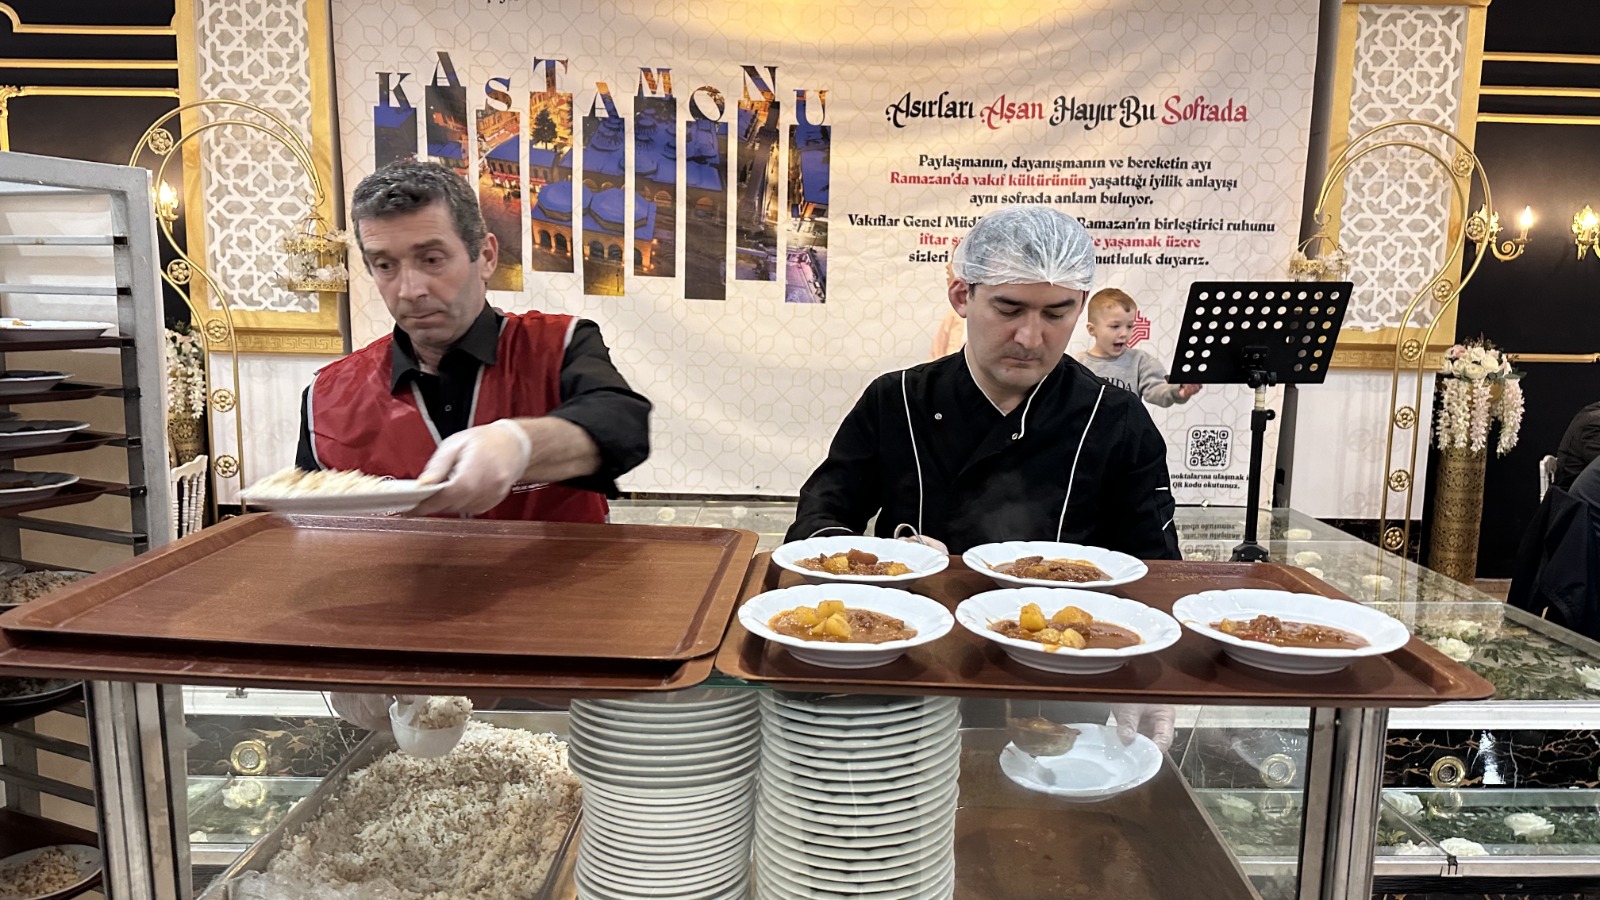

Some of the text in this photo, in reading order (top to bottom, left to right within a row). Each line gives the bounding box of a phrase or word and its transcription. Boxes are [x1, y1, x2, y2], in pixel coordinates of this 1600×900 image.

[375, 51, 829, 126] KASTAMONU
[885, 91, 1249, 131] Asırları Aşan Hayır Bu Sofrada
[919, 154, 1212, 173] Paylaşmanın, dayanışmanın ve bereketin ayı
[890, 171, 1238, 192] Ramazan'da vakıf kültürünün yaşattığı iyilik anlayışı
[969, 191, 1154, 208] aynı sofrada anlam buluyor.
[848, 213, 900, 227] Vakıflar
[903, 215, 942, 228] Genel
[945, 215, 983, 228] Müd
[1154, 218, 1224, 234] birleştirici
[1226, 219, 1275, 232] ruhunu
[919, 233, 949, 245] iftar
[1102, 236, 1162, 251] yaşamak
[1165, 236, 1201, 248] üzere
[908, 250, 949, 264] sizleri
[1155, 253, 1210, 269] duyarız.
[1172, 481, 1183, 489] QR
[1203, 481, 1241, 489] okutunuz.
[1213, 473, 1245, 482] ulaşmak
